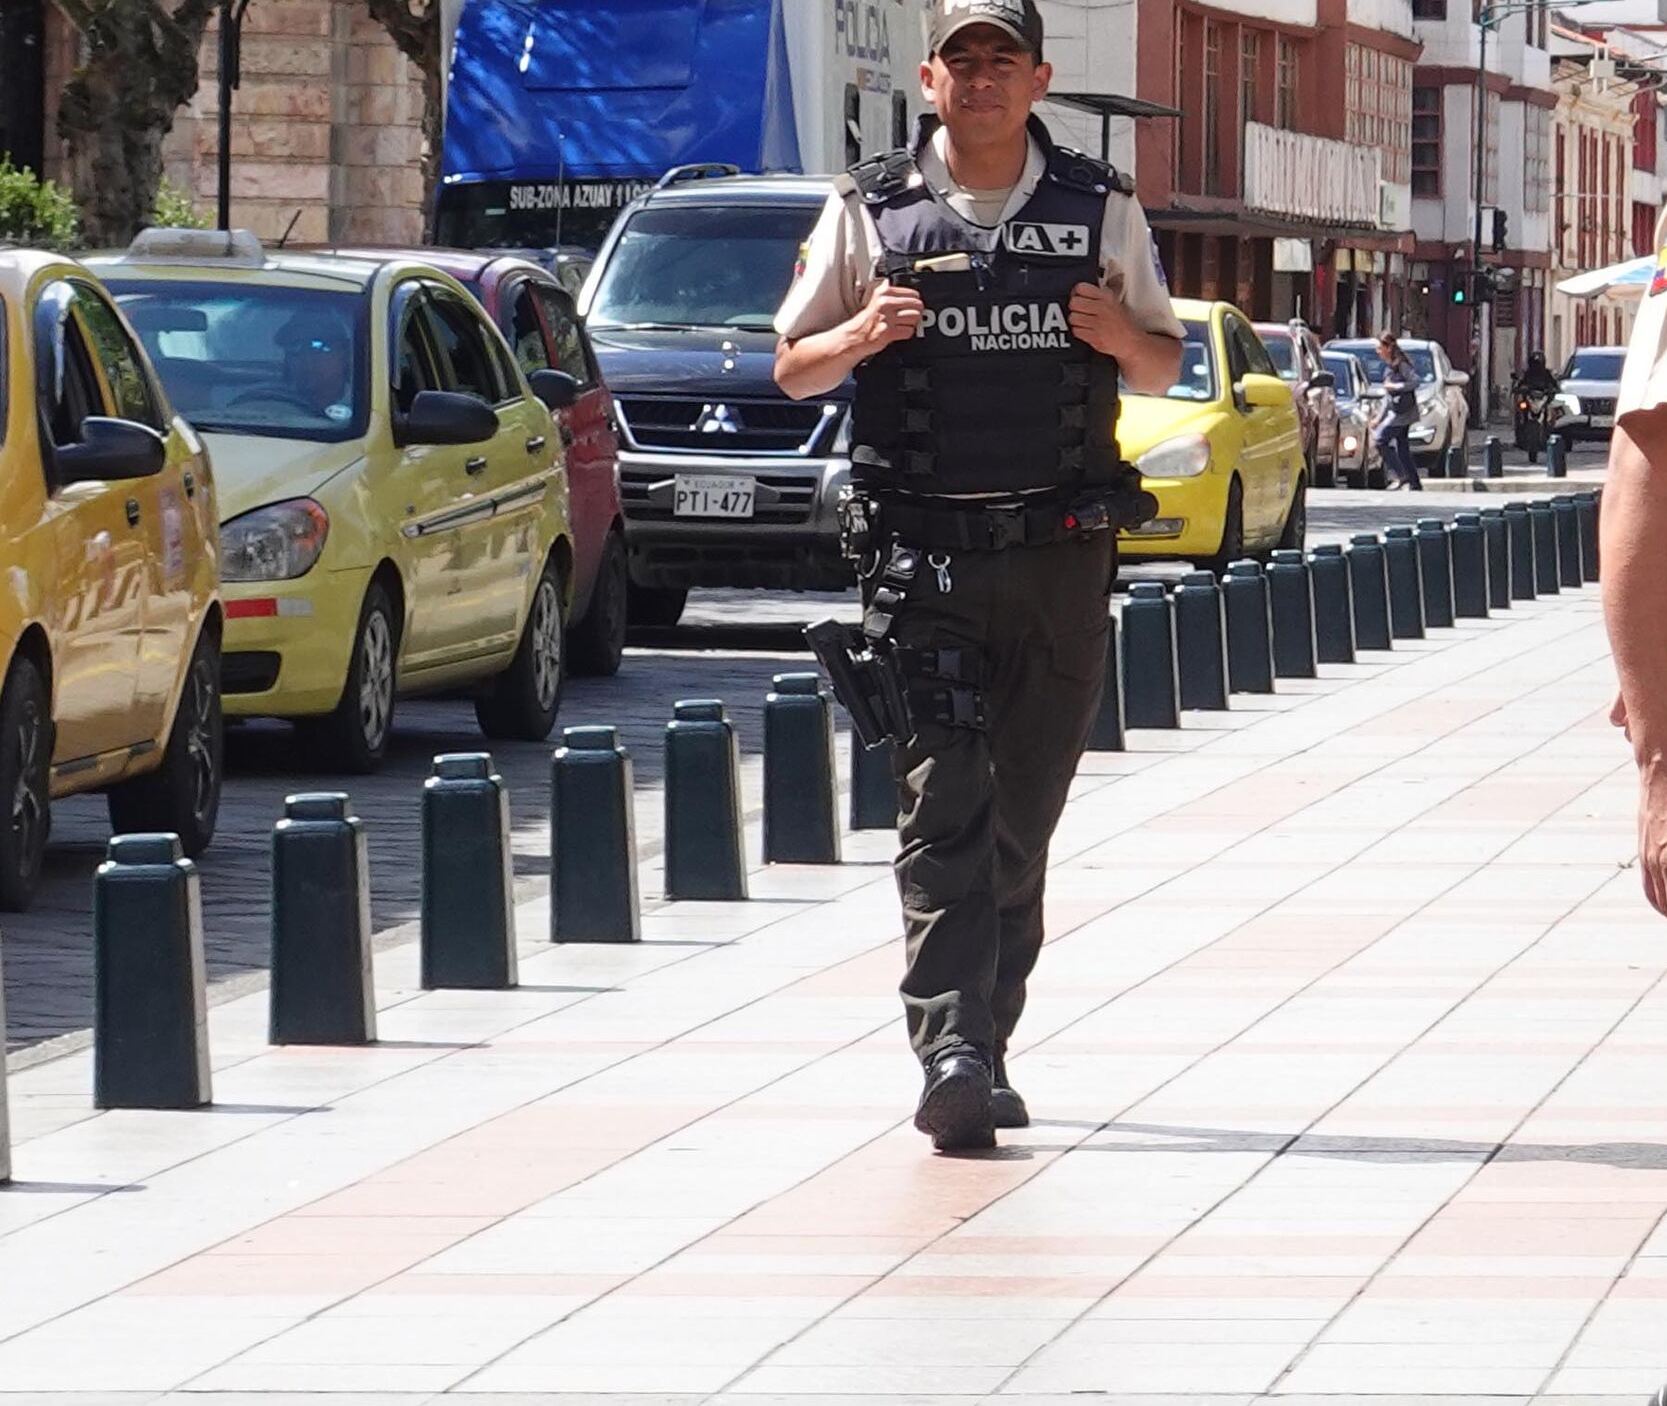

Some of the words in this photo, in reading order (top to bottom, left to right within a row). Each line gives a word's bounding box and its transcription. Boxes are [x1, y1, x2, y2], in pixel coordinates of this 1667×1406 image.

[510, 184, 571, 209] SUB-ZONA
[572, 184, 613, 208] AZUAY
[916, 302, 1069, 338] POLICIA
[971, 332, 1071, 351] NACIONAL
[677, 491, 752, 513] PTI-477
